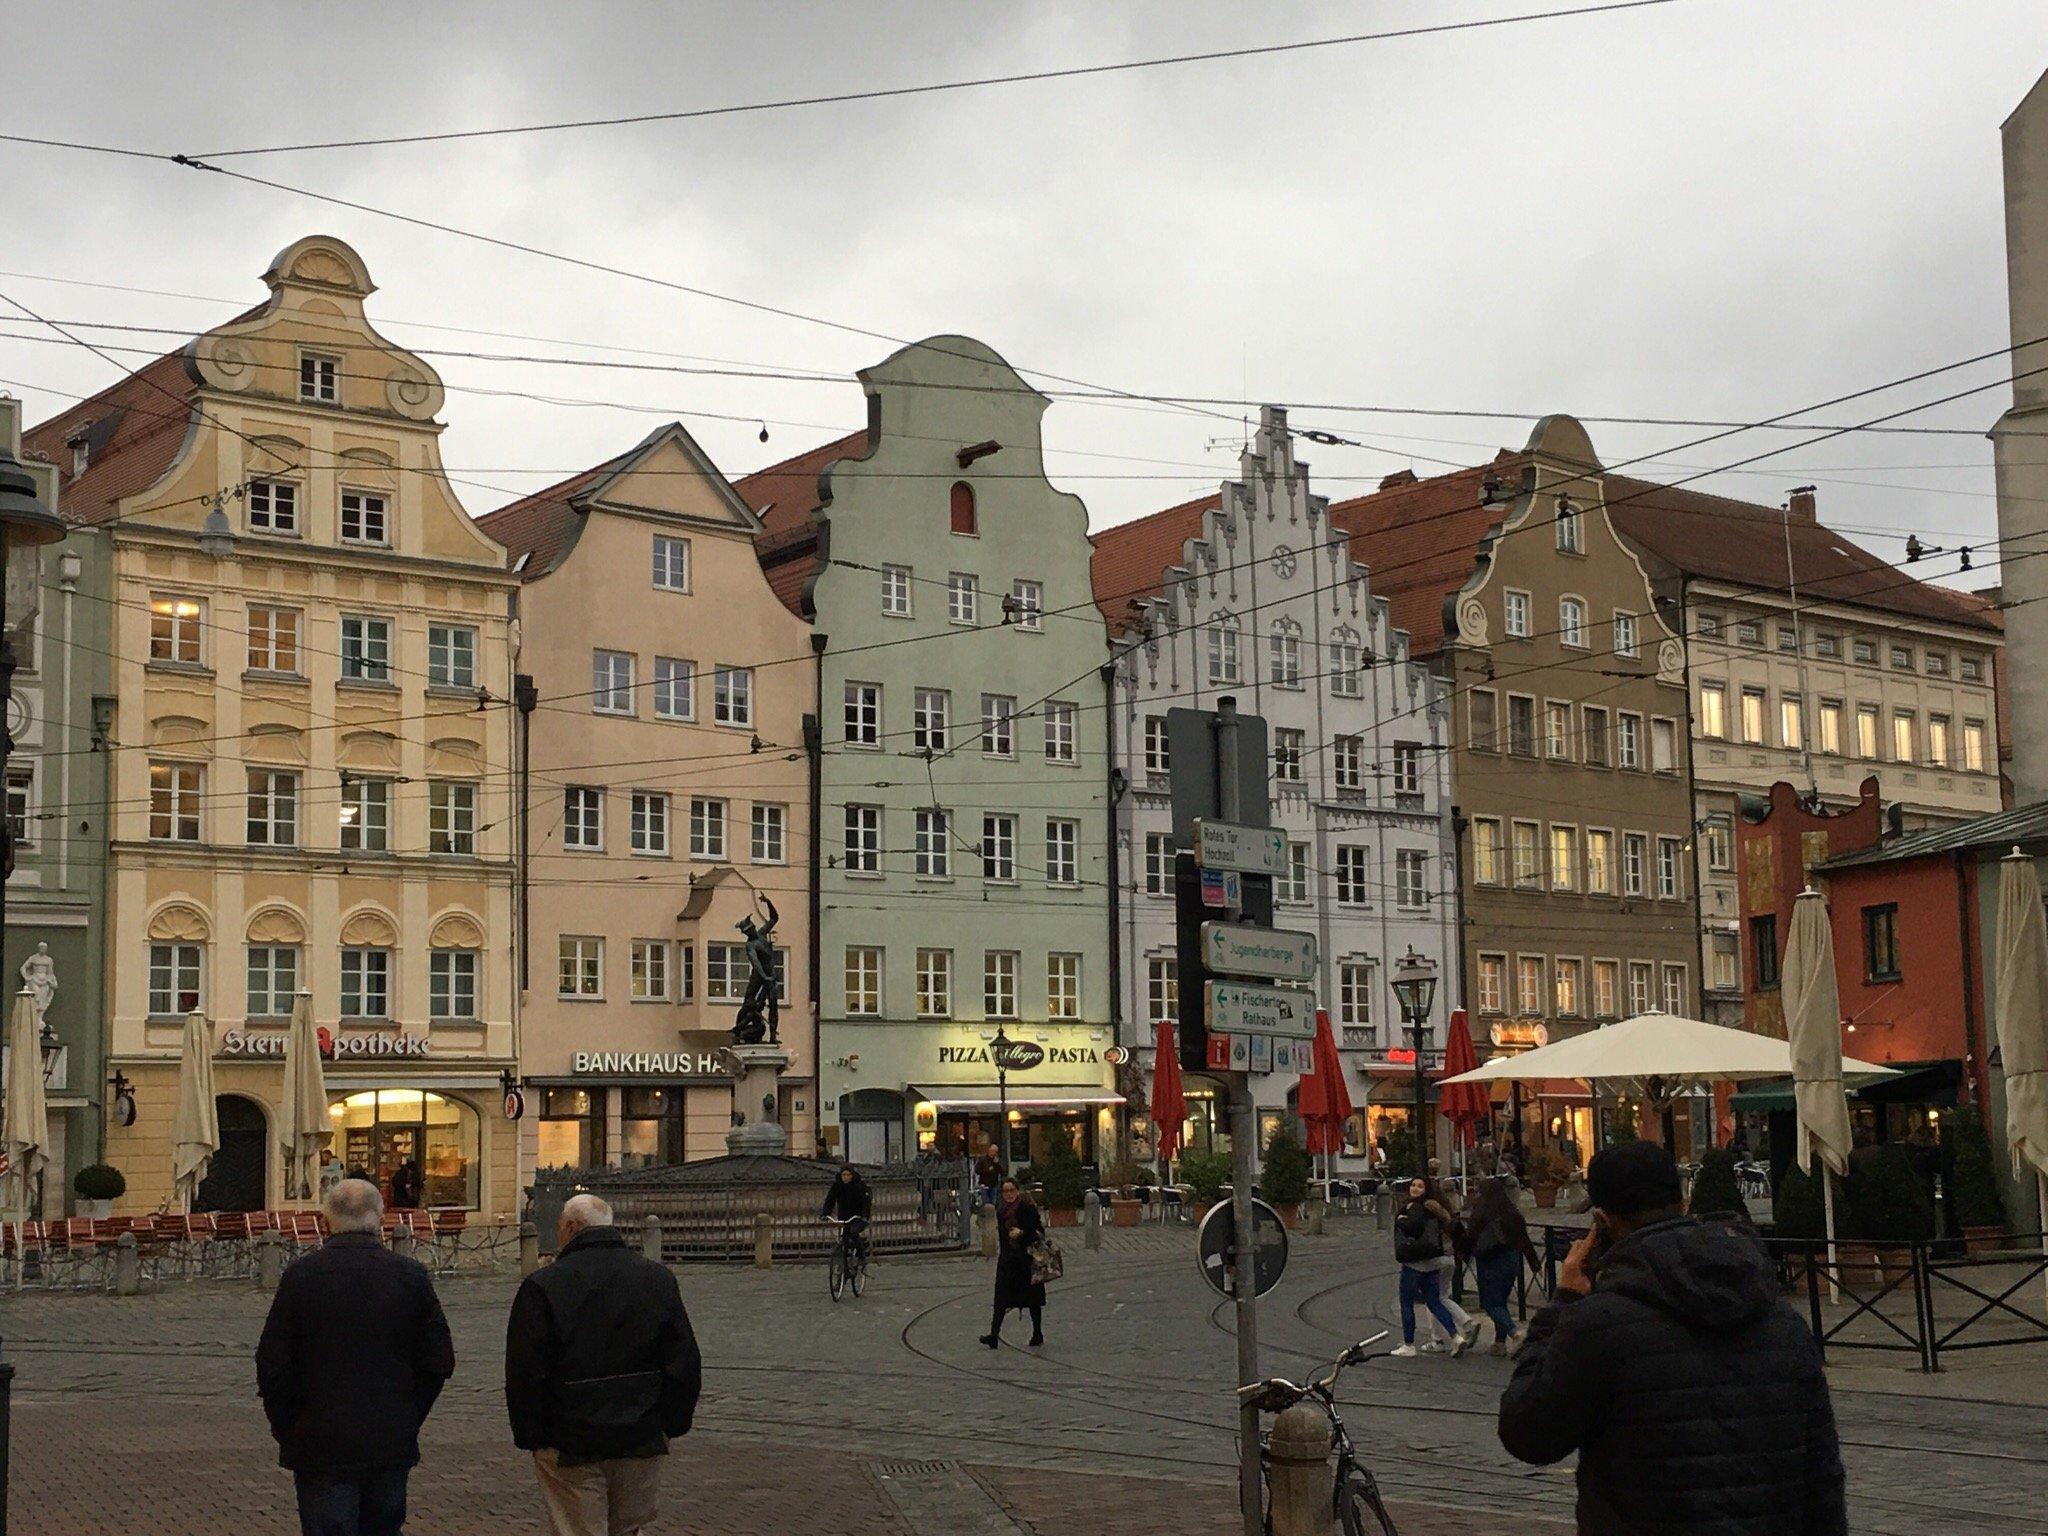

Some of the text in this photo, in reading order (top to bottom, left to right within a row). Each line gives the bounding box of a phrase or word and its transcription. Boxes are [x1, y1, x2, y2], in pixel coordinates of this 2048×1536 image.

[1241, 1010, 1277, 1027] Rathaus
[316, 1026, 431, 1060] Apotheke
[575, 1051, 692, 1073] BANKHAUS
[939, 1047, 989, 1063] PIZZA
[1049, 1047, 1099, 1064] PASTA
